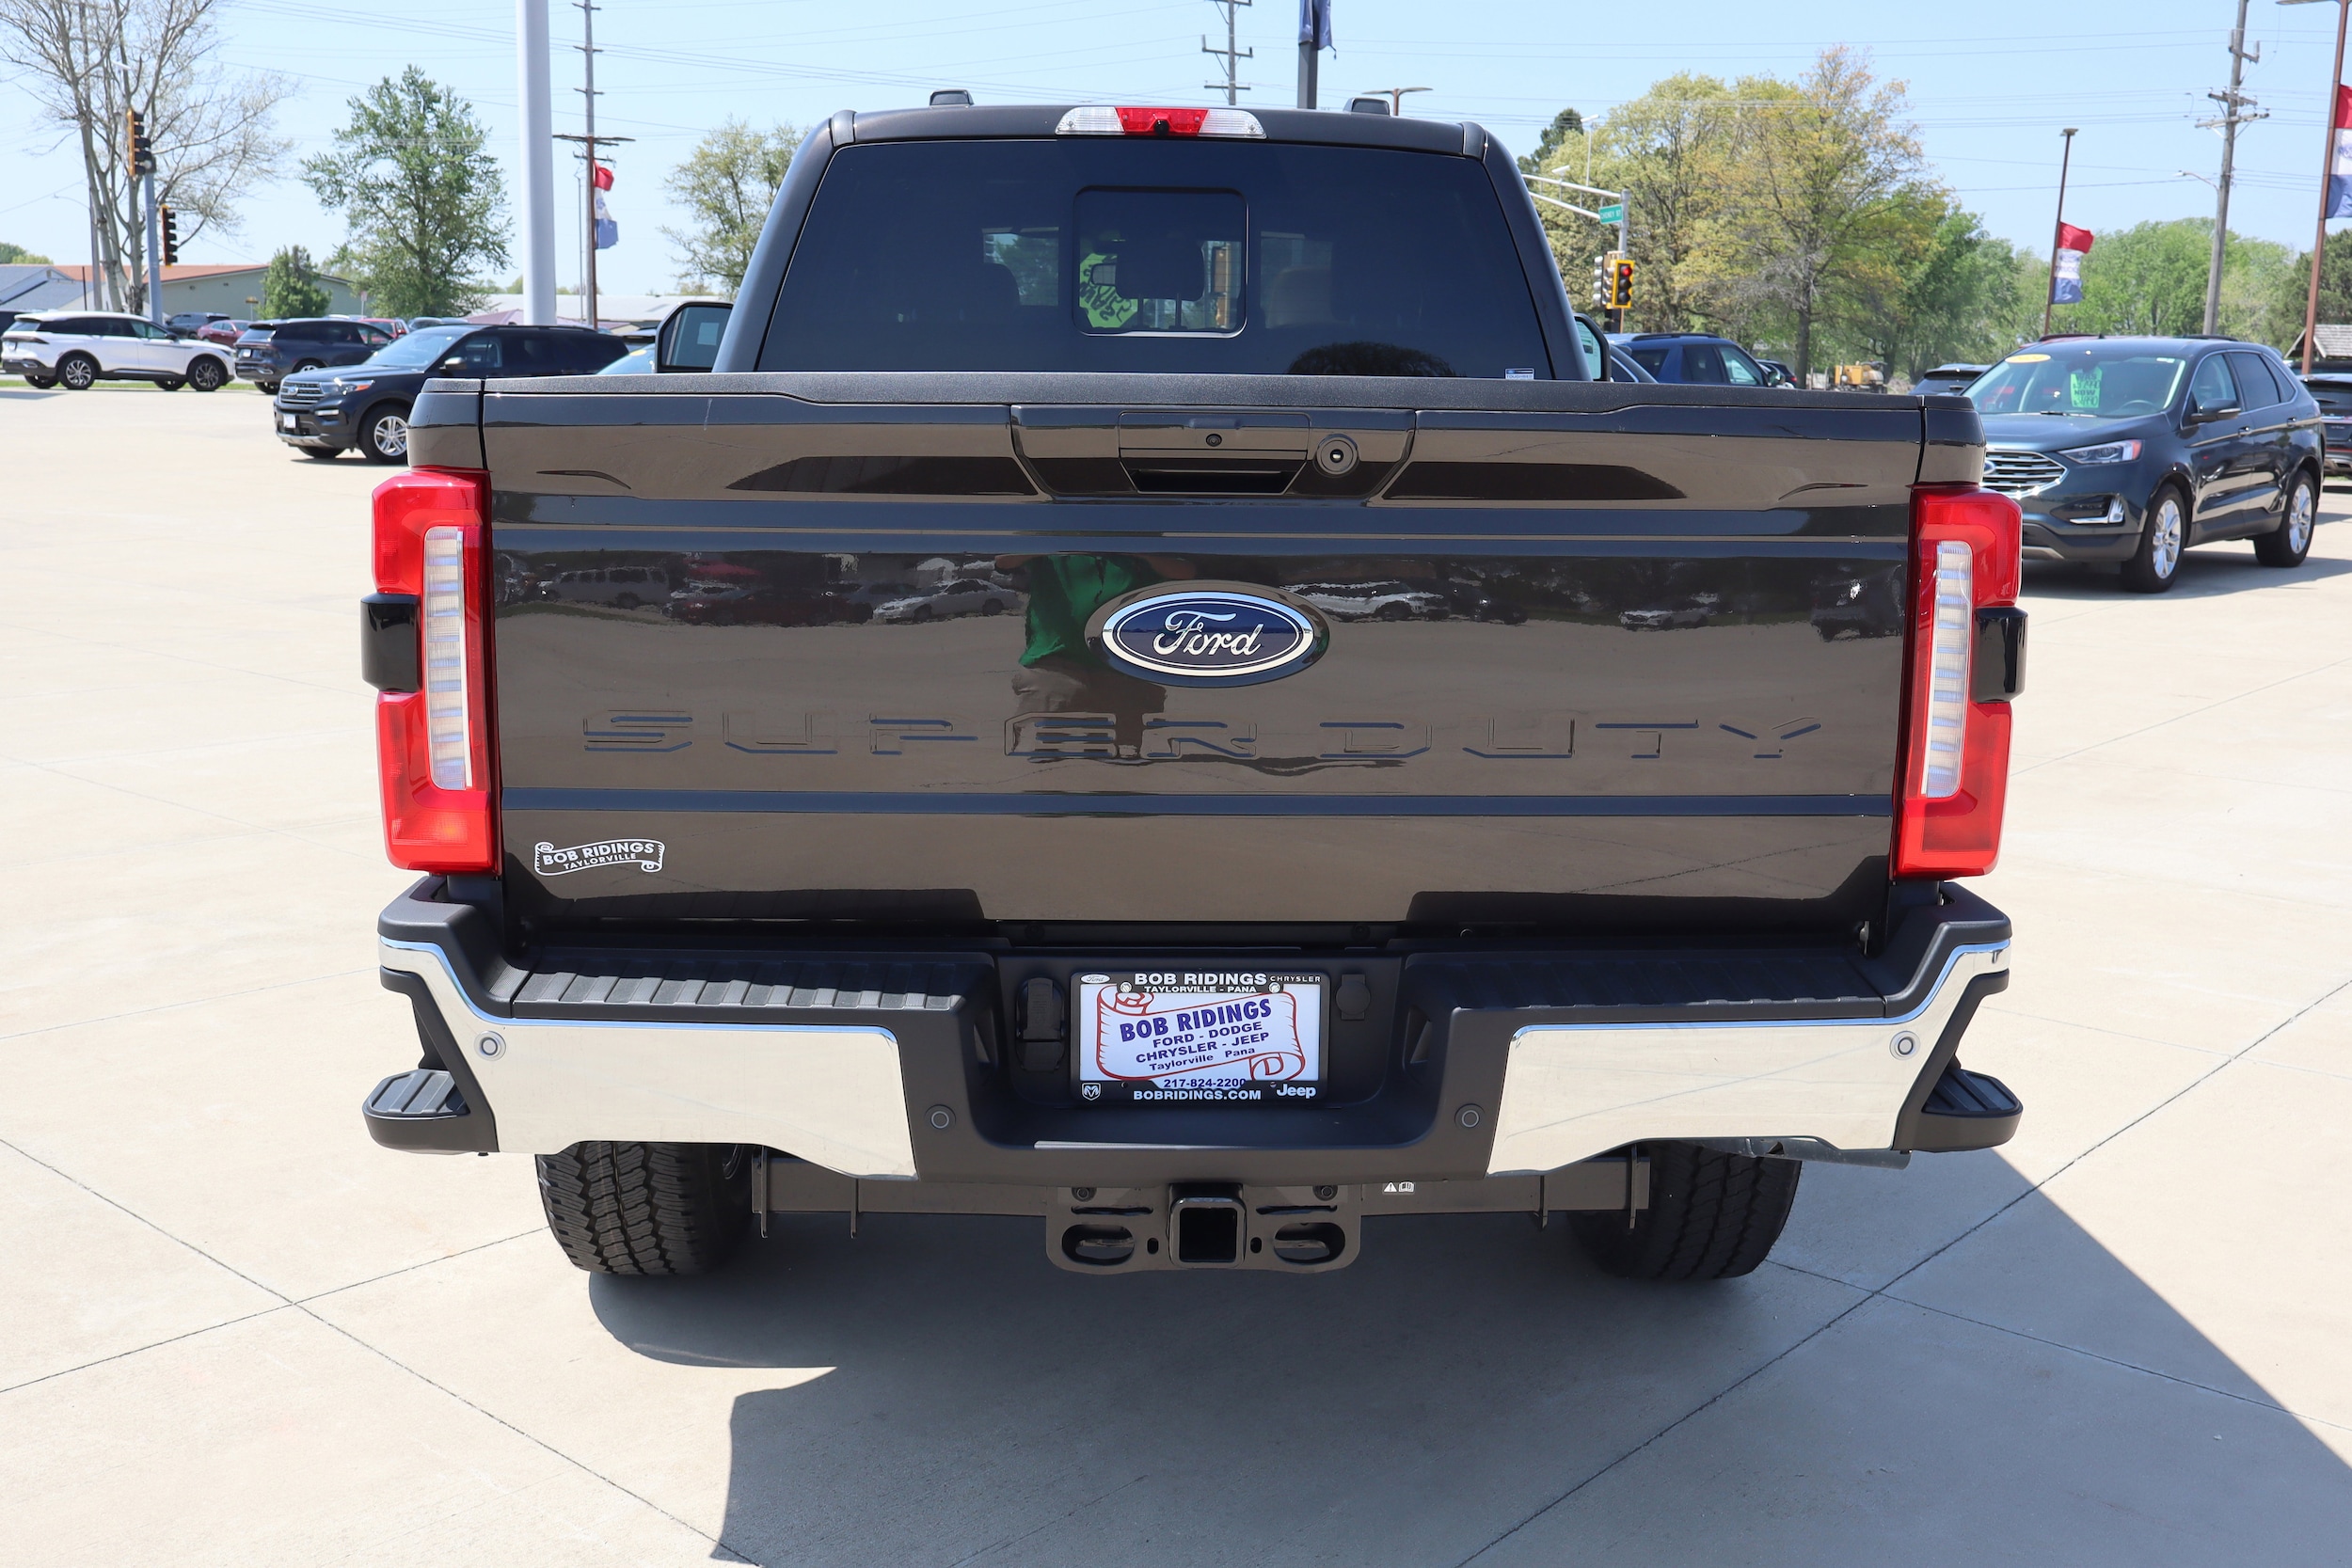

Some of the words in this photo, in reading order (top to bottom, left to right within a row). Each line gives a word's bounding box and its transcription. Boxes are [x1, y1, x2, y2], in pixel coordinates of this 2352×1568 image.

[1152, 610, 1264, 656] Ford
[582, 709, 1258, 760] SUPER
[1315, 711, 1822, 760] DUTY
[542, 850, 580, 865] BOB
[581, 842, 655, 859] RIDINGS
[563, 852, 637, 870] TAYLORVILLE
[1134, 973, 1178, 986] BOB
[1184, 973, 1267, 986] RIDINGS
[1120, 1017, 1169, 1042] BOB
[1176, 998, 1272, 1032] RIDINGS
[1152, 1033, 1195, 1048] FORD
[1208, 1021, 1263, 1038] DODGE
[1136, 1041, 1218, 1063] CHRYSLER
[1232, 1032, 1270, 1047] JEEP
[1149, 1054, 1214, 1071] Taylorville
[1225, 1047, 1255, 1058] Pana
[1133, 1090, 1262, 1101] BOBRIDINGS.COM
[1276, 1083, 1316, 1100] Jeep
